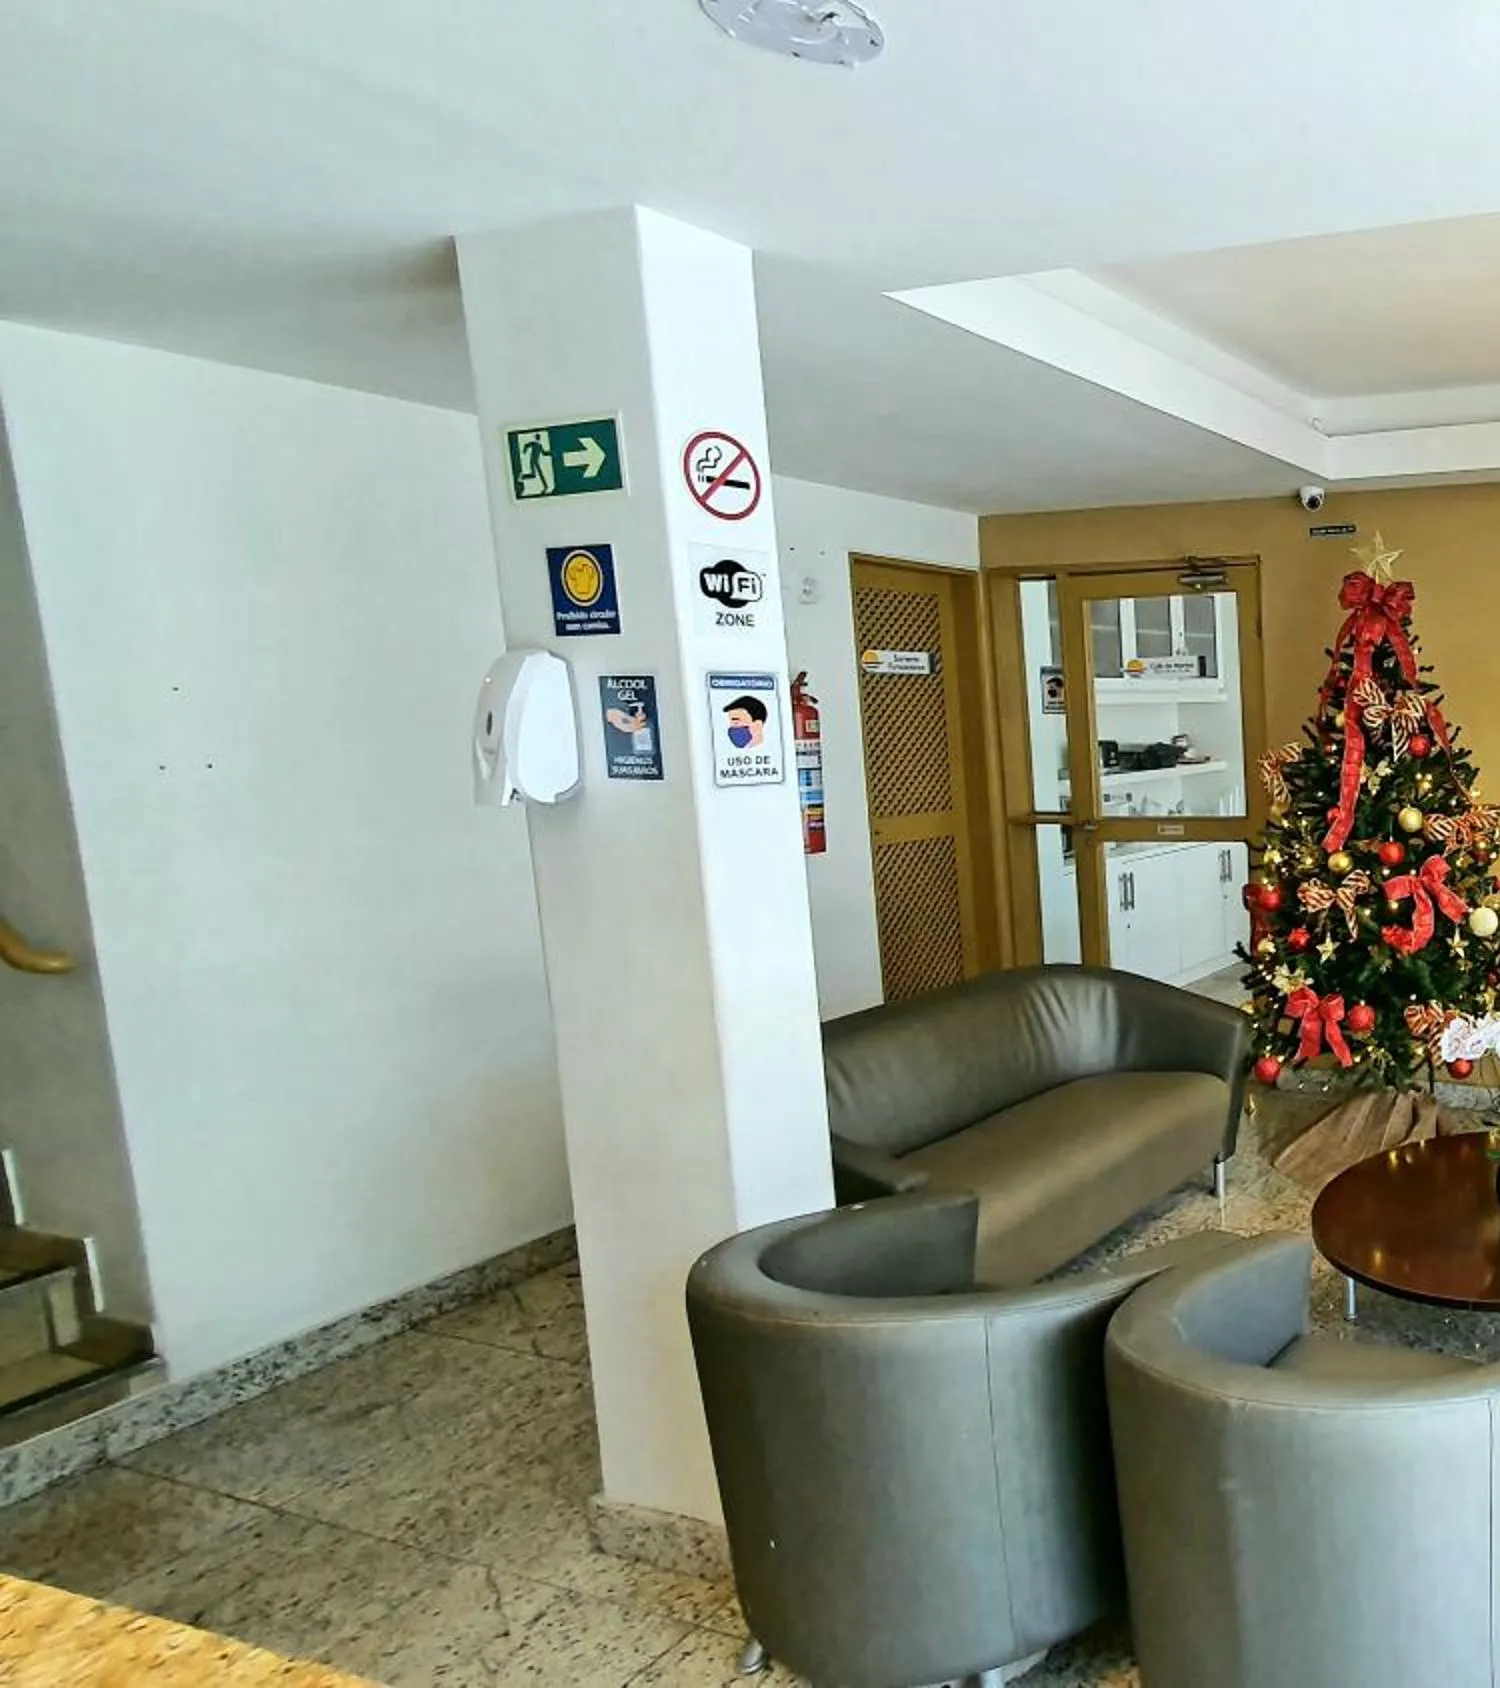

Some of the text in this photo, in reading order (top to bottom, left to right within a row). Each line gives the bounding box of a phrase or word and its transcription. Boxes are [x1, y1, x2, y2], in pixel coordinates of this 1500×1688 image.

[715, 611, 755, 627] ZONE
[617, 689, 638, 701] GEL
[727, 755, 772, 766] USO DE
